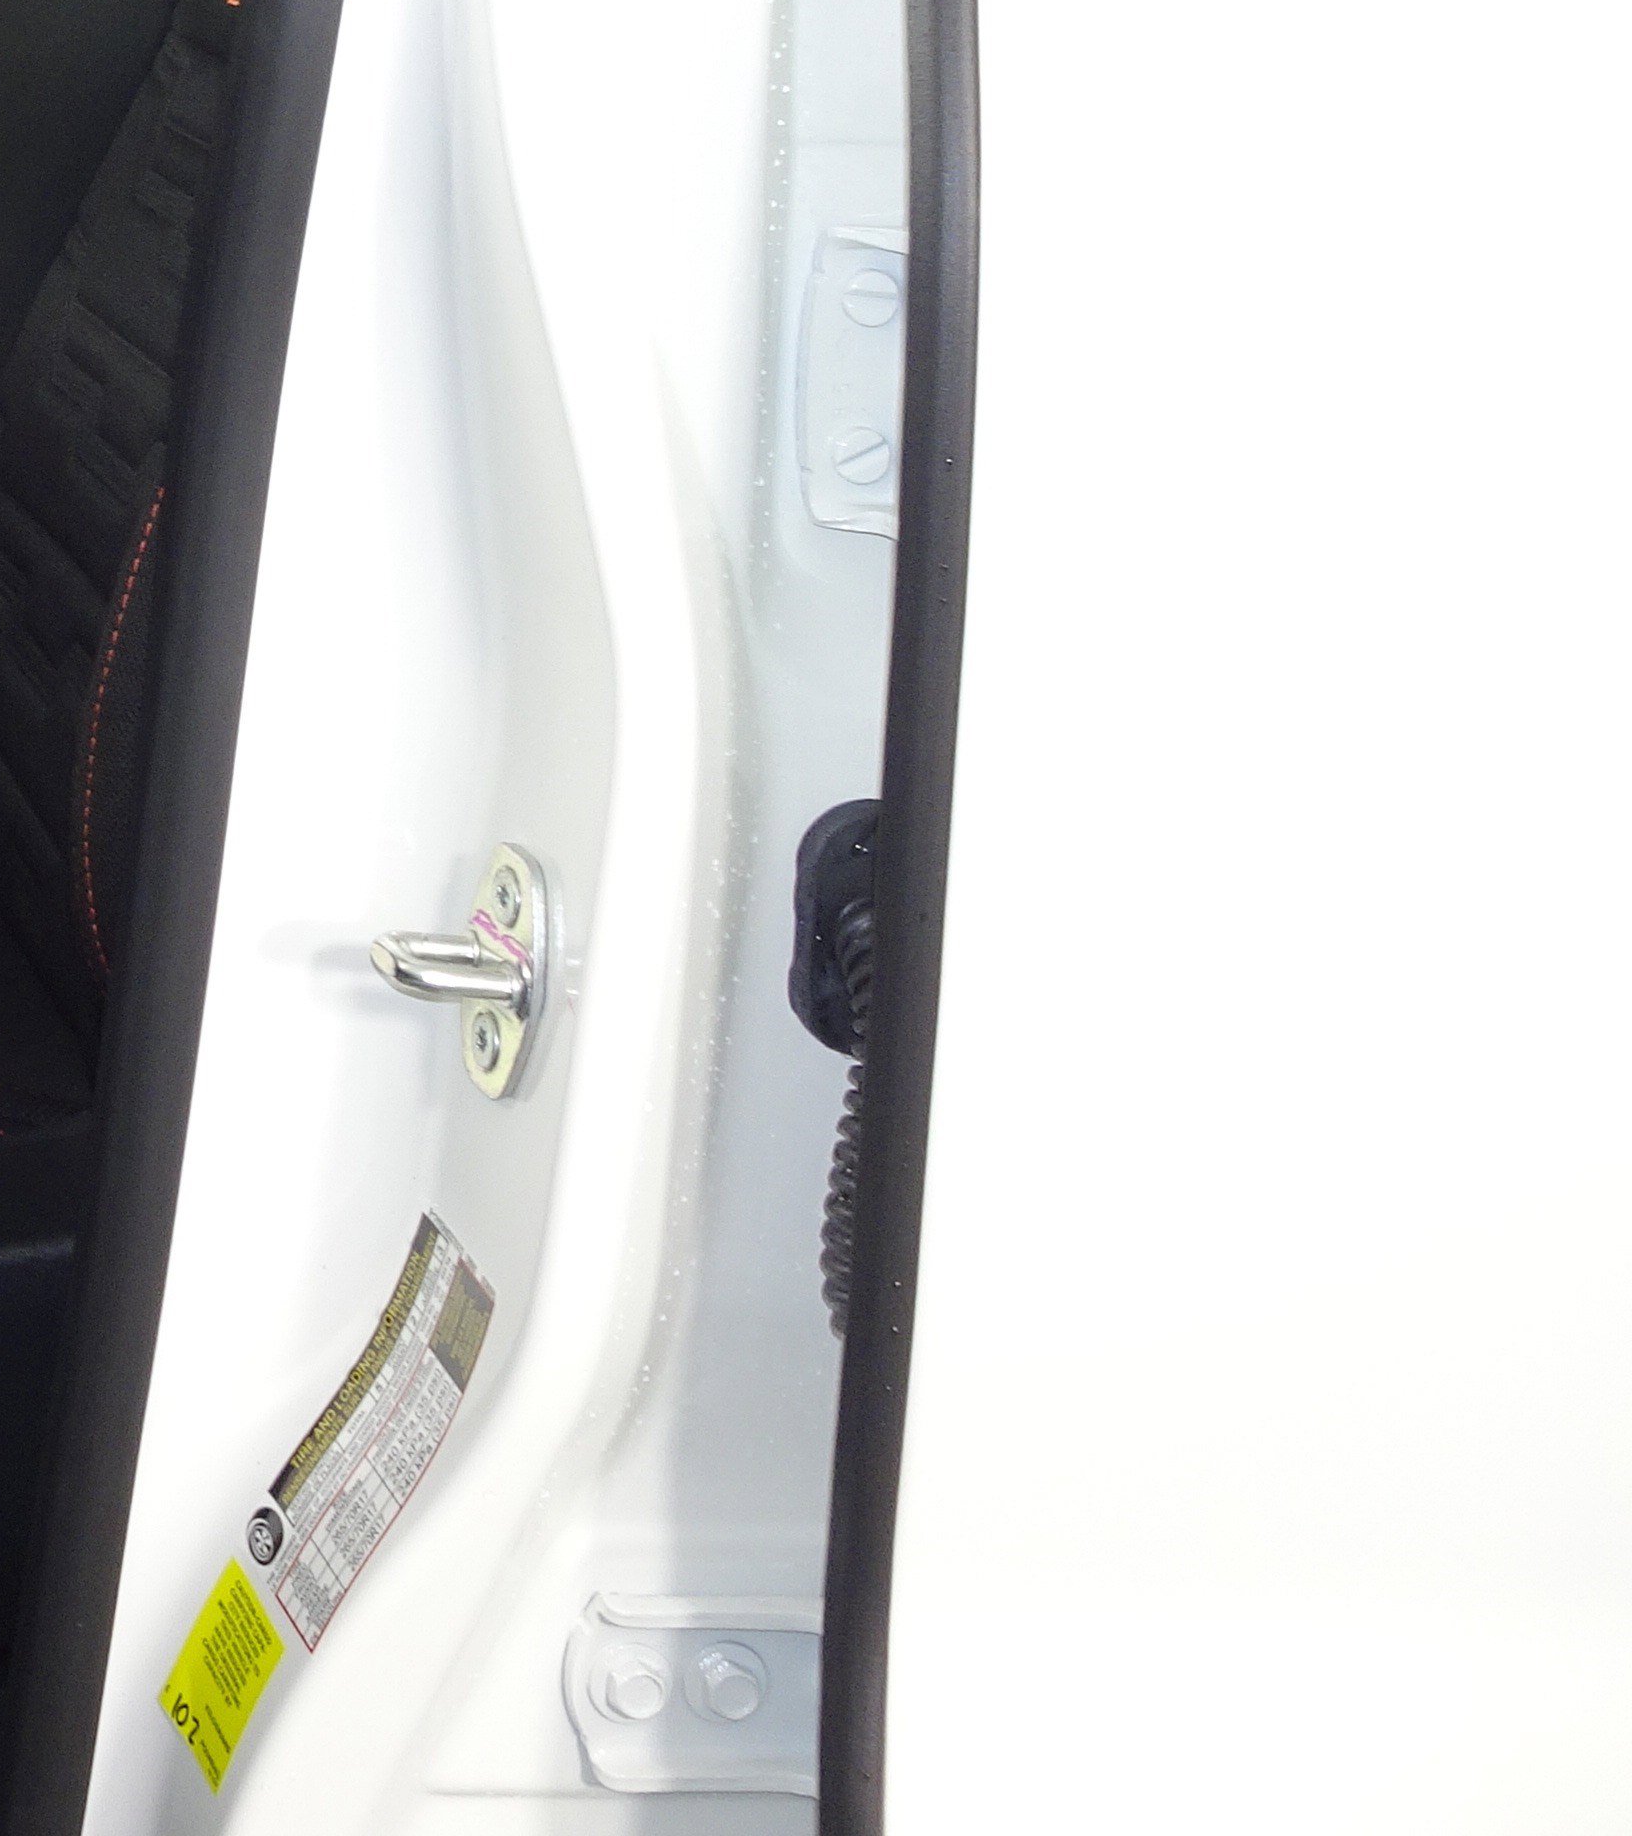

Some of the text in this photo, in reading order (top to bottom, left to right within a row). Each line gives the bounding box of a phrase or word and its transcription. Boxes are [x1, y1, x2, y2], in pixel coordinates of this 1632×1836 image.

[289, 1436, 314, 1471] TIRE
[311, 1405, 337, 1441] AND
[333, 1344, 376, 1412] LOADING
